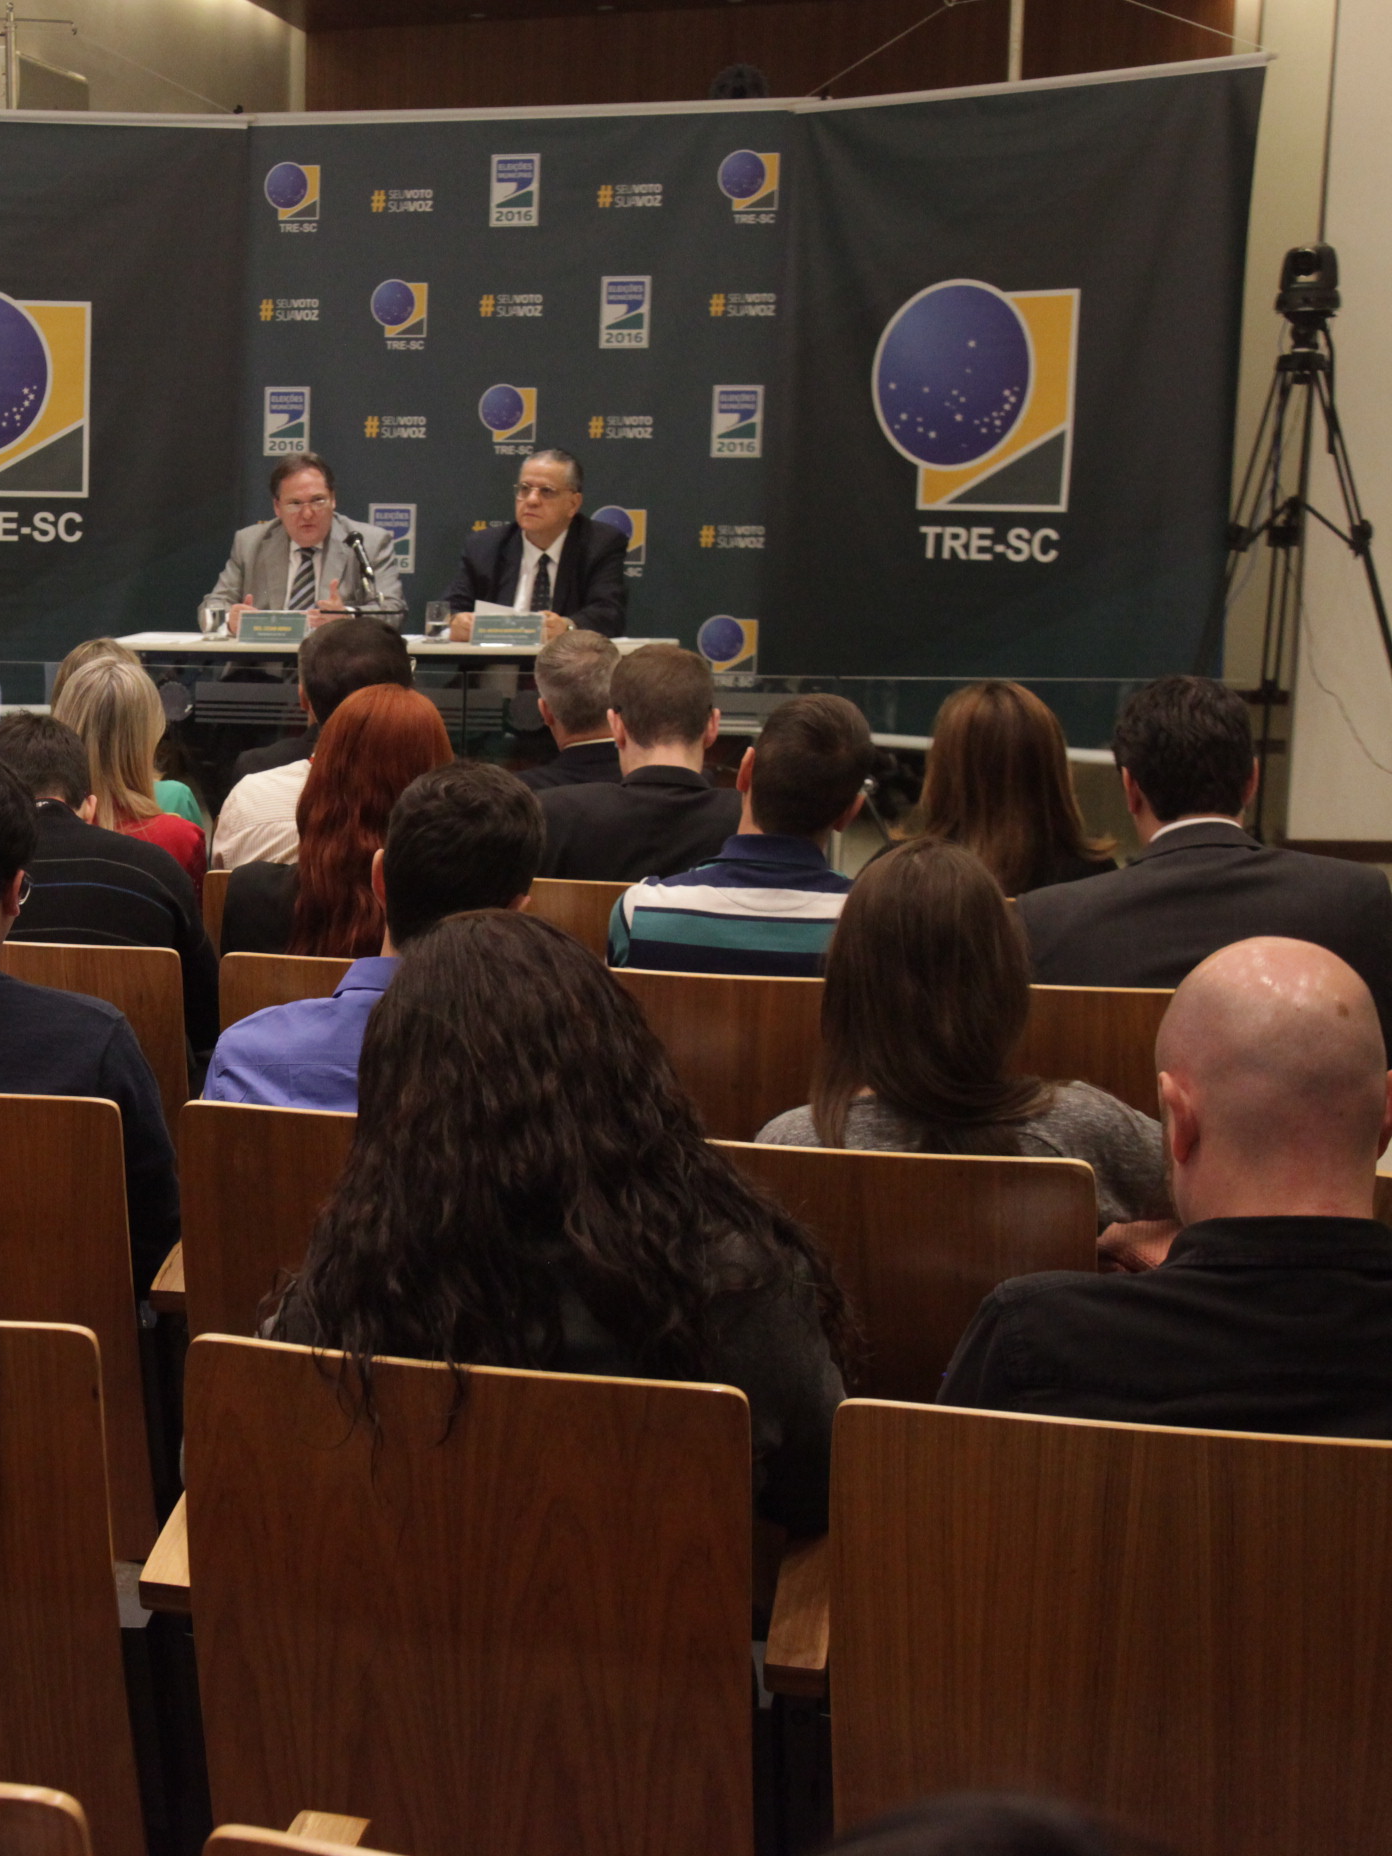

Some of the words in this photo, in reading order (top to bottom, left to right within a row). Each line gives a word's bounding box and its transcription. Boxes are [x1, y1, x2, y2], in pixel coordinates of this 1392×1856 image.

[495, 211, 533, 222] 2016
[279, 223, 318, 233] TRE-SC
[605, 332, 643, 343] 2016
[386, 340, 425, 350] TRE-SC
[269, 440, 304, 451] 2016
[717, 441, 756, 452] 2016
[919, 525, 1060, 563] TRE-SC
